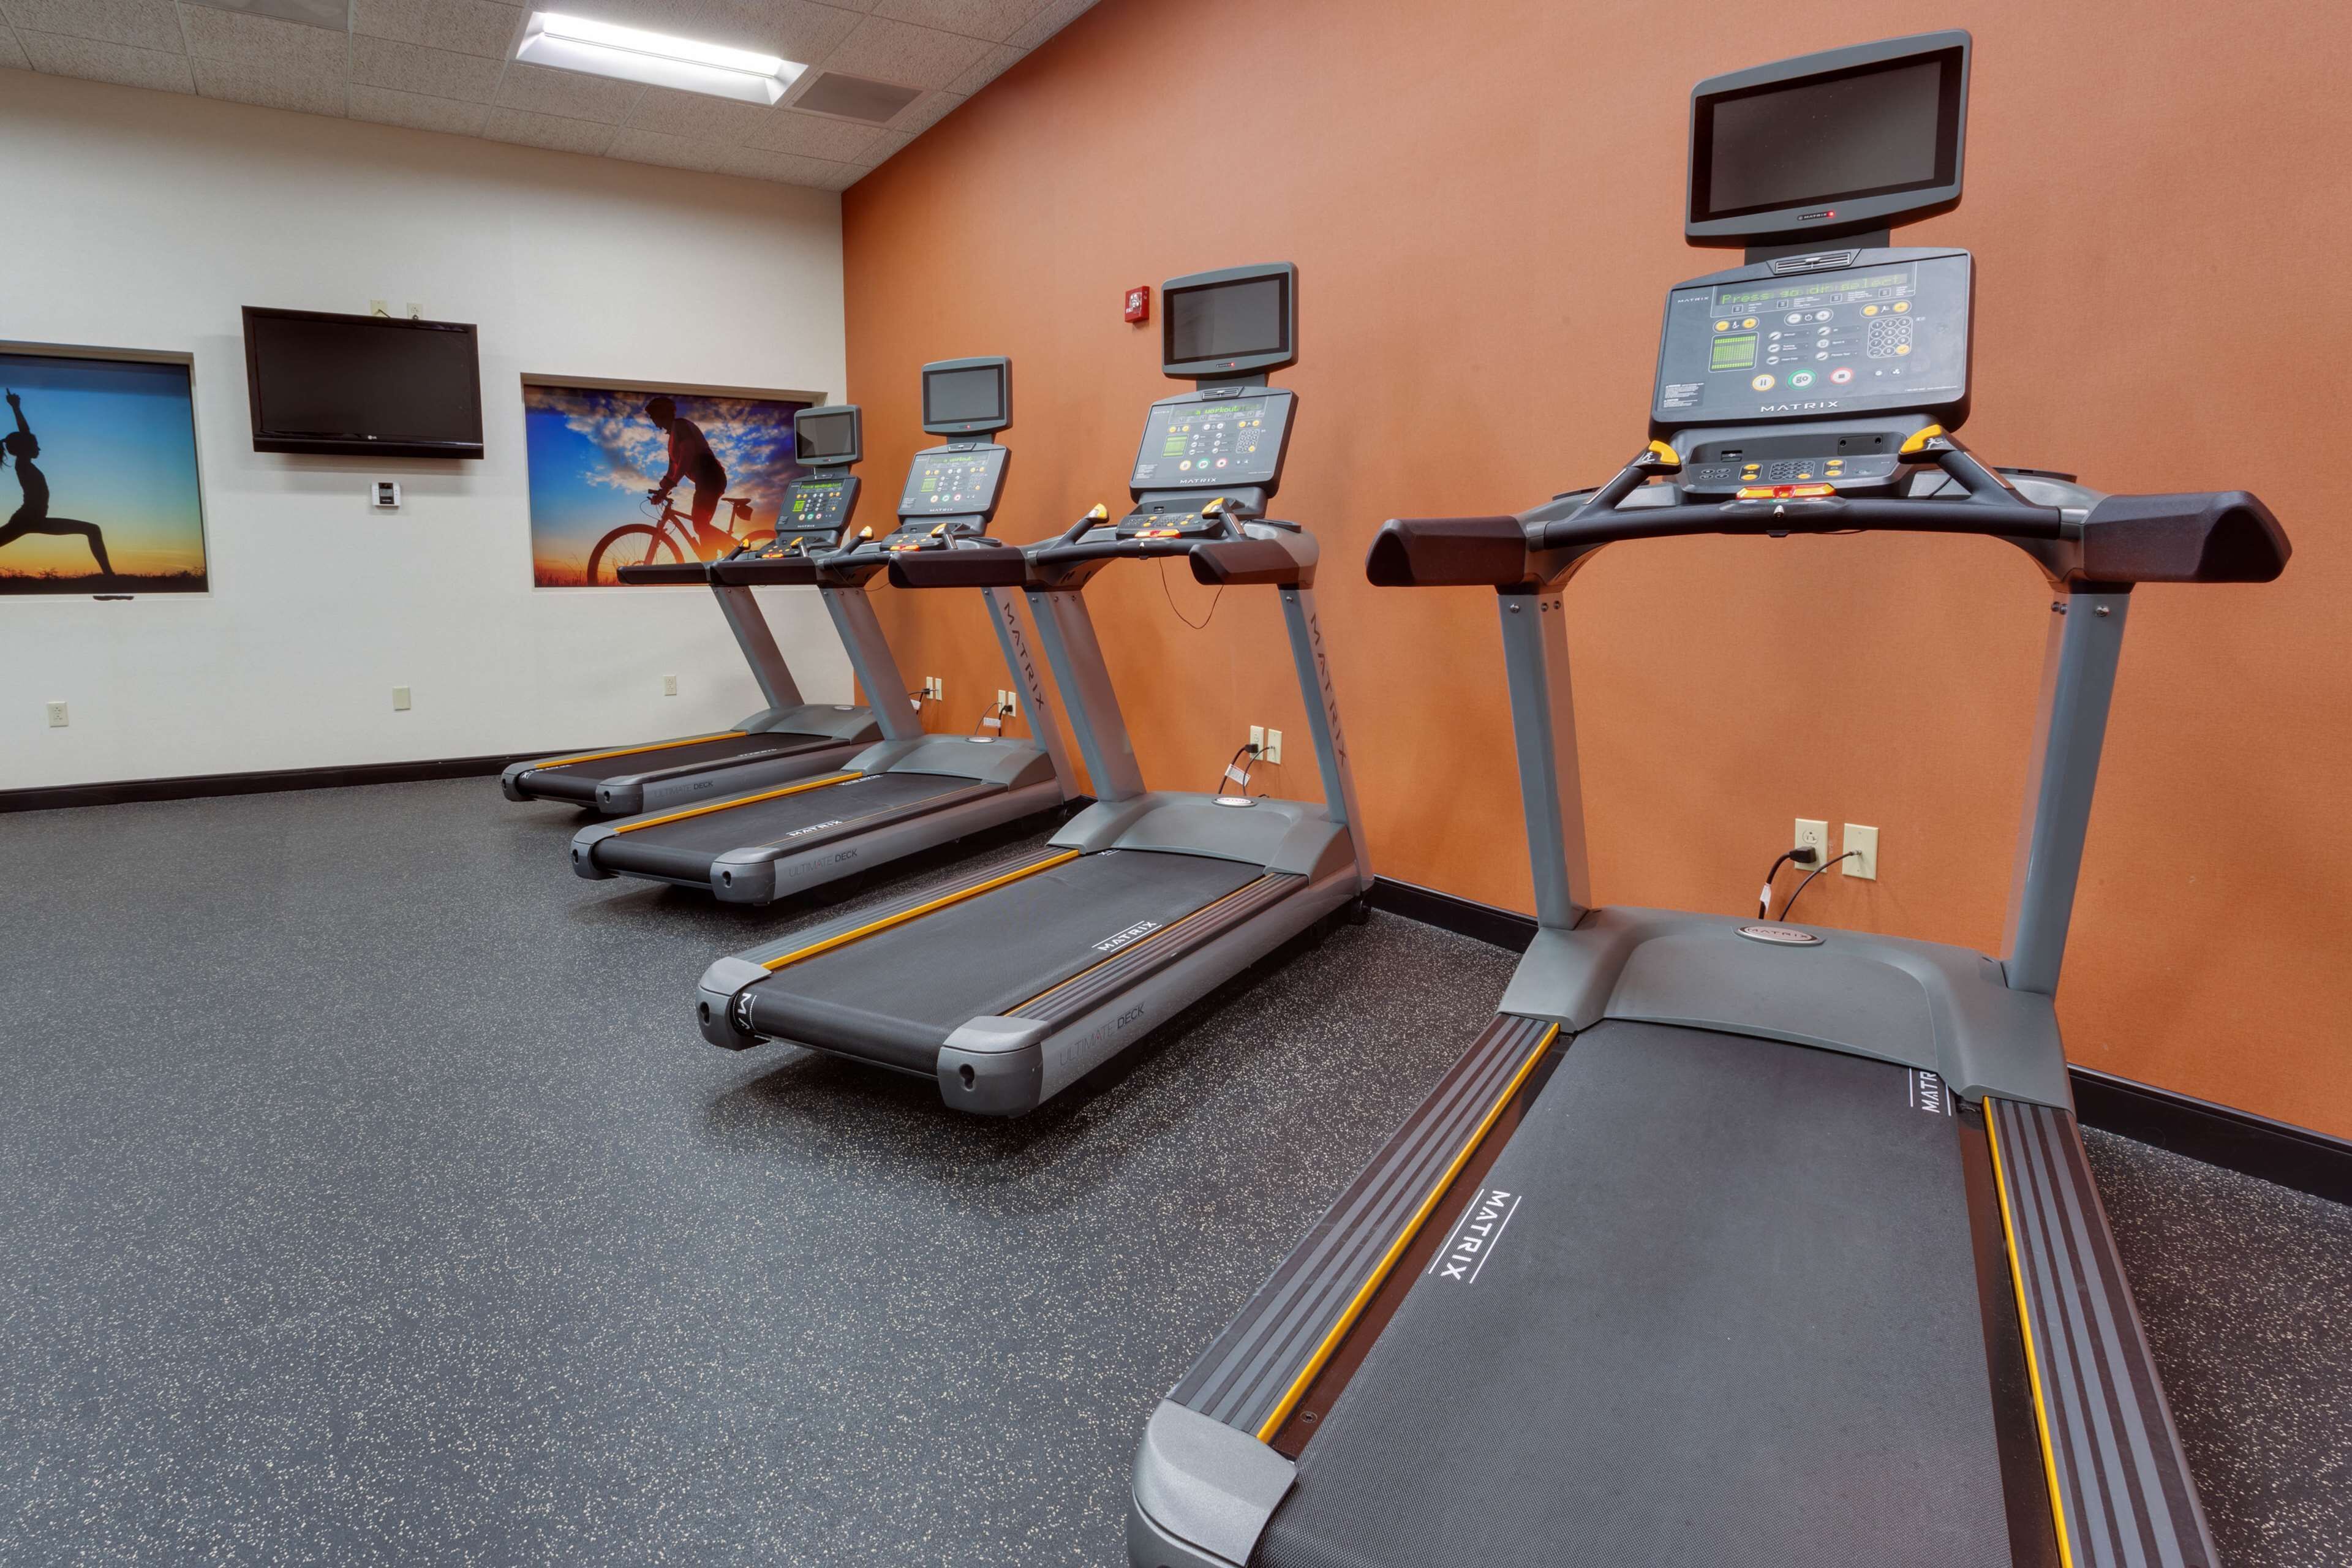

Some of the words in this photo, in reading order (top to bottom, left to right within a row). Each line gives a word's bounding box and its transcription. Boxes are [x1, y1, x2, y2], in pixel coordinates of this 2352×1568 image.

[1722, 293, 1770, 304] Press
[1760, 401, 1839, 412] MATRIX
[1004, 602, 1044, 711] MATRIX
[1310, 612, 1347, 767] MATRIX
[693, 780, 714, 790] DECK
[788, 855, 834, 877] ULTIMATE
[834, 848, 858, 863] DECK
[1098, 921, 1157, 951] MATRIX
[1059, 1019, 1116, 1066] ULTIMATE
[1116, 1004, 1145, 1030] DECK
[1440, 1190, 1511, 1280] MATRIX
